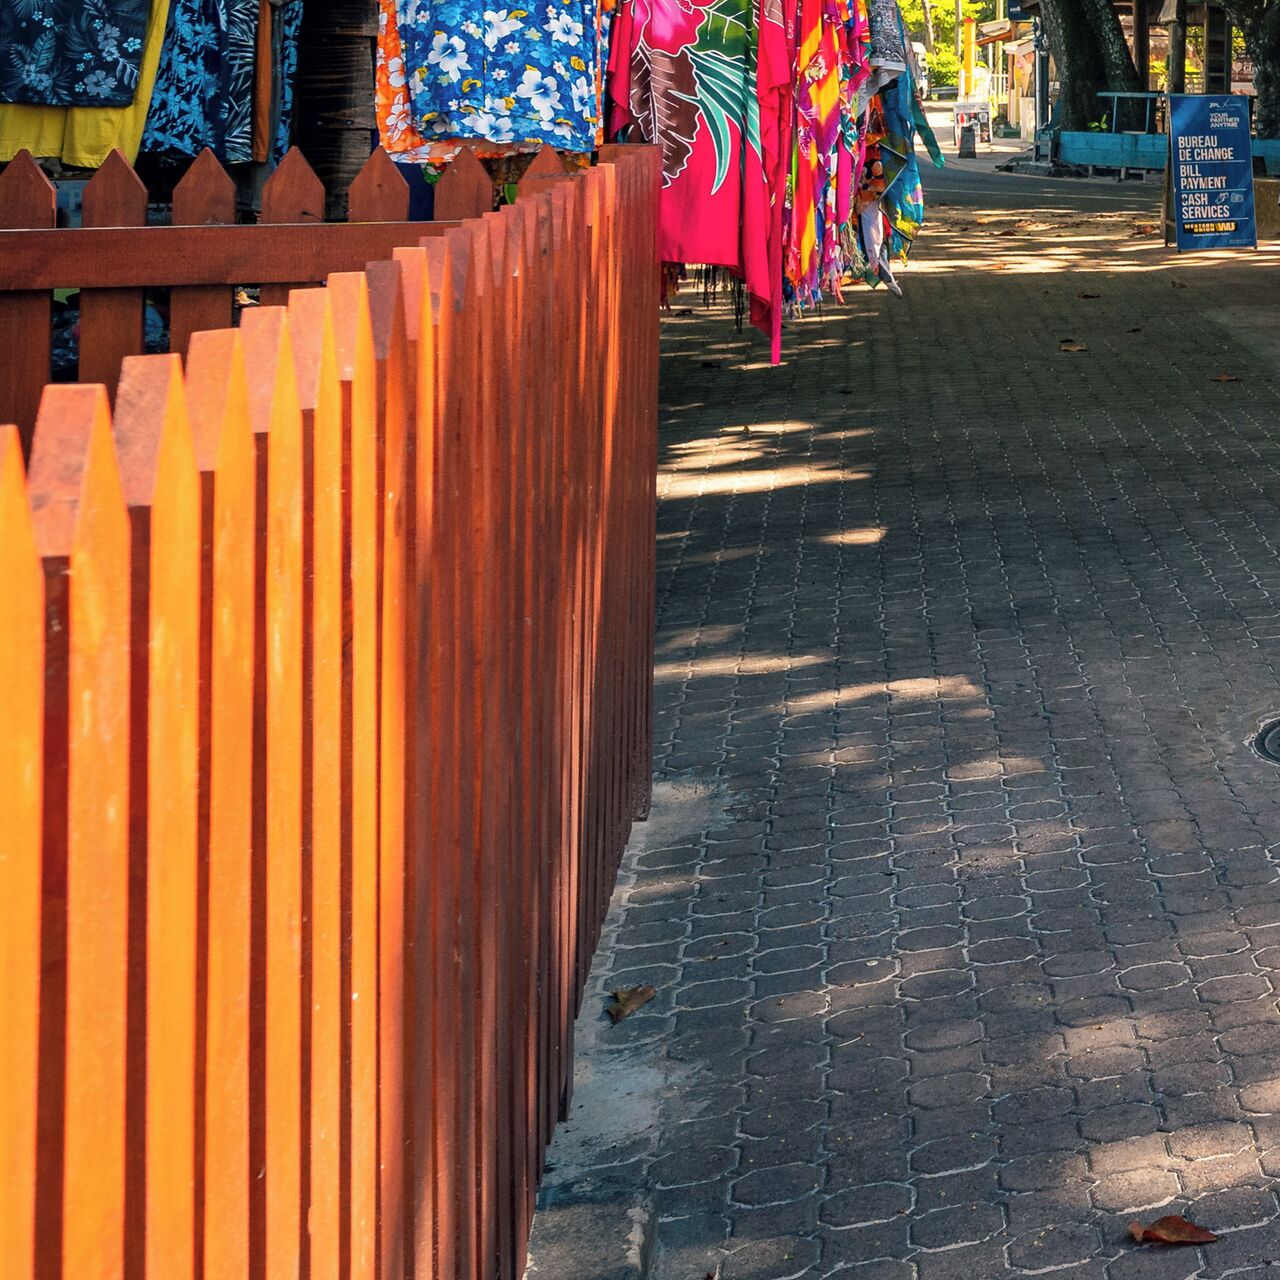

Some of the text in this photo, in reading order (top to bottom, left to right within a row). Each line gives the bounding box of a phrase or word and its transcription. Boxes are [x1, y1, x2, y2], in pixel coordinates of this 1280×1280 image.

[1178, 135, 1218, 149] BUREAU
[1179, 148, 1234, 161] DE CHANGE
[1180, 164, 1202, 177] BILL
[1181, 176, 1227, 190] PAYMENT
[1182, 193, 1208, 206] CASH
[1182, 205, 1230, 219] SERVICES
